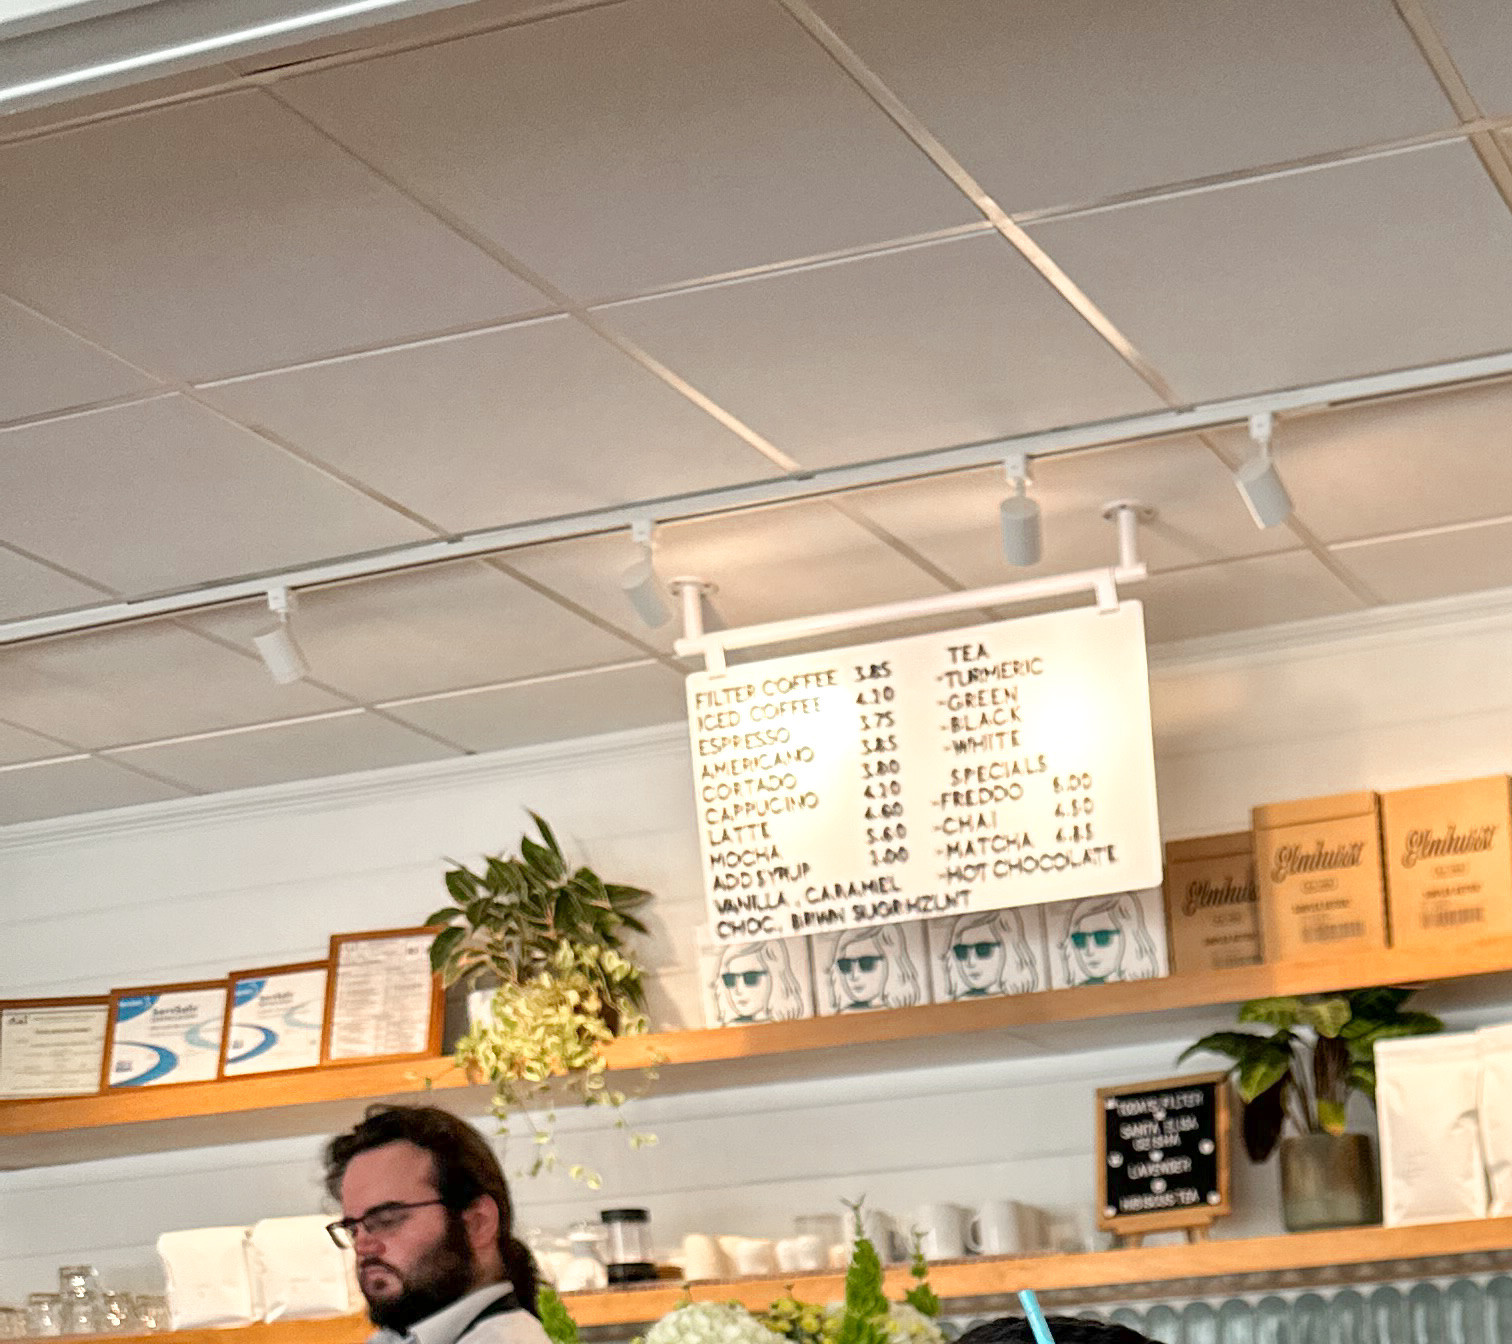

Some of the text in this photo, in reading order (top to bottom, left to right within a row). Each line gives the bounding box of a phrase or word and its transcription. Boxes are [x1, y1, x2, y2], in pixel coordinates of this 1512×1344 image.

[948, 643, 989, 664] TEA
[695, 685, 755, 709] FILTER
[762, 669, 838, 696] COFFEE
[698, 711, 740, 732] ICED
[750, 697, 821, 722] COFFEE
[699, 727, 790, 756] ESPRESSO
[702, 746, 814, 779] AMERICANO
[951, 754, 1048, 786] SPECIALS
[703, 773, 797, 802] CORTADO
[708, 822, 771, 846] LATTE
[710, 845, 782, 869] MOCHA
[994, 844, 1118, 878] CHOCOLATE
[714, 872, 752, 891] ADD
[805, 876, 900, 904] CARAMEL
